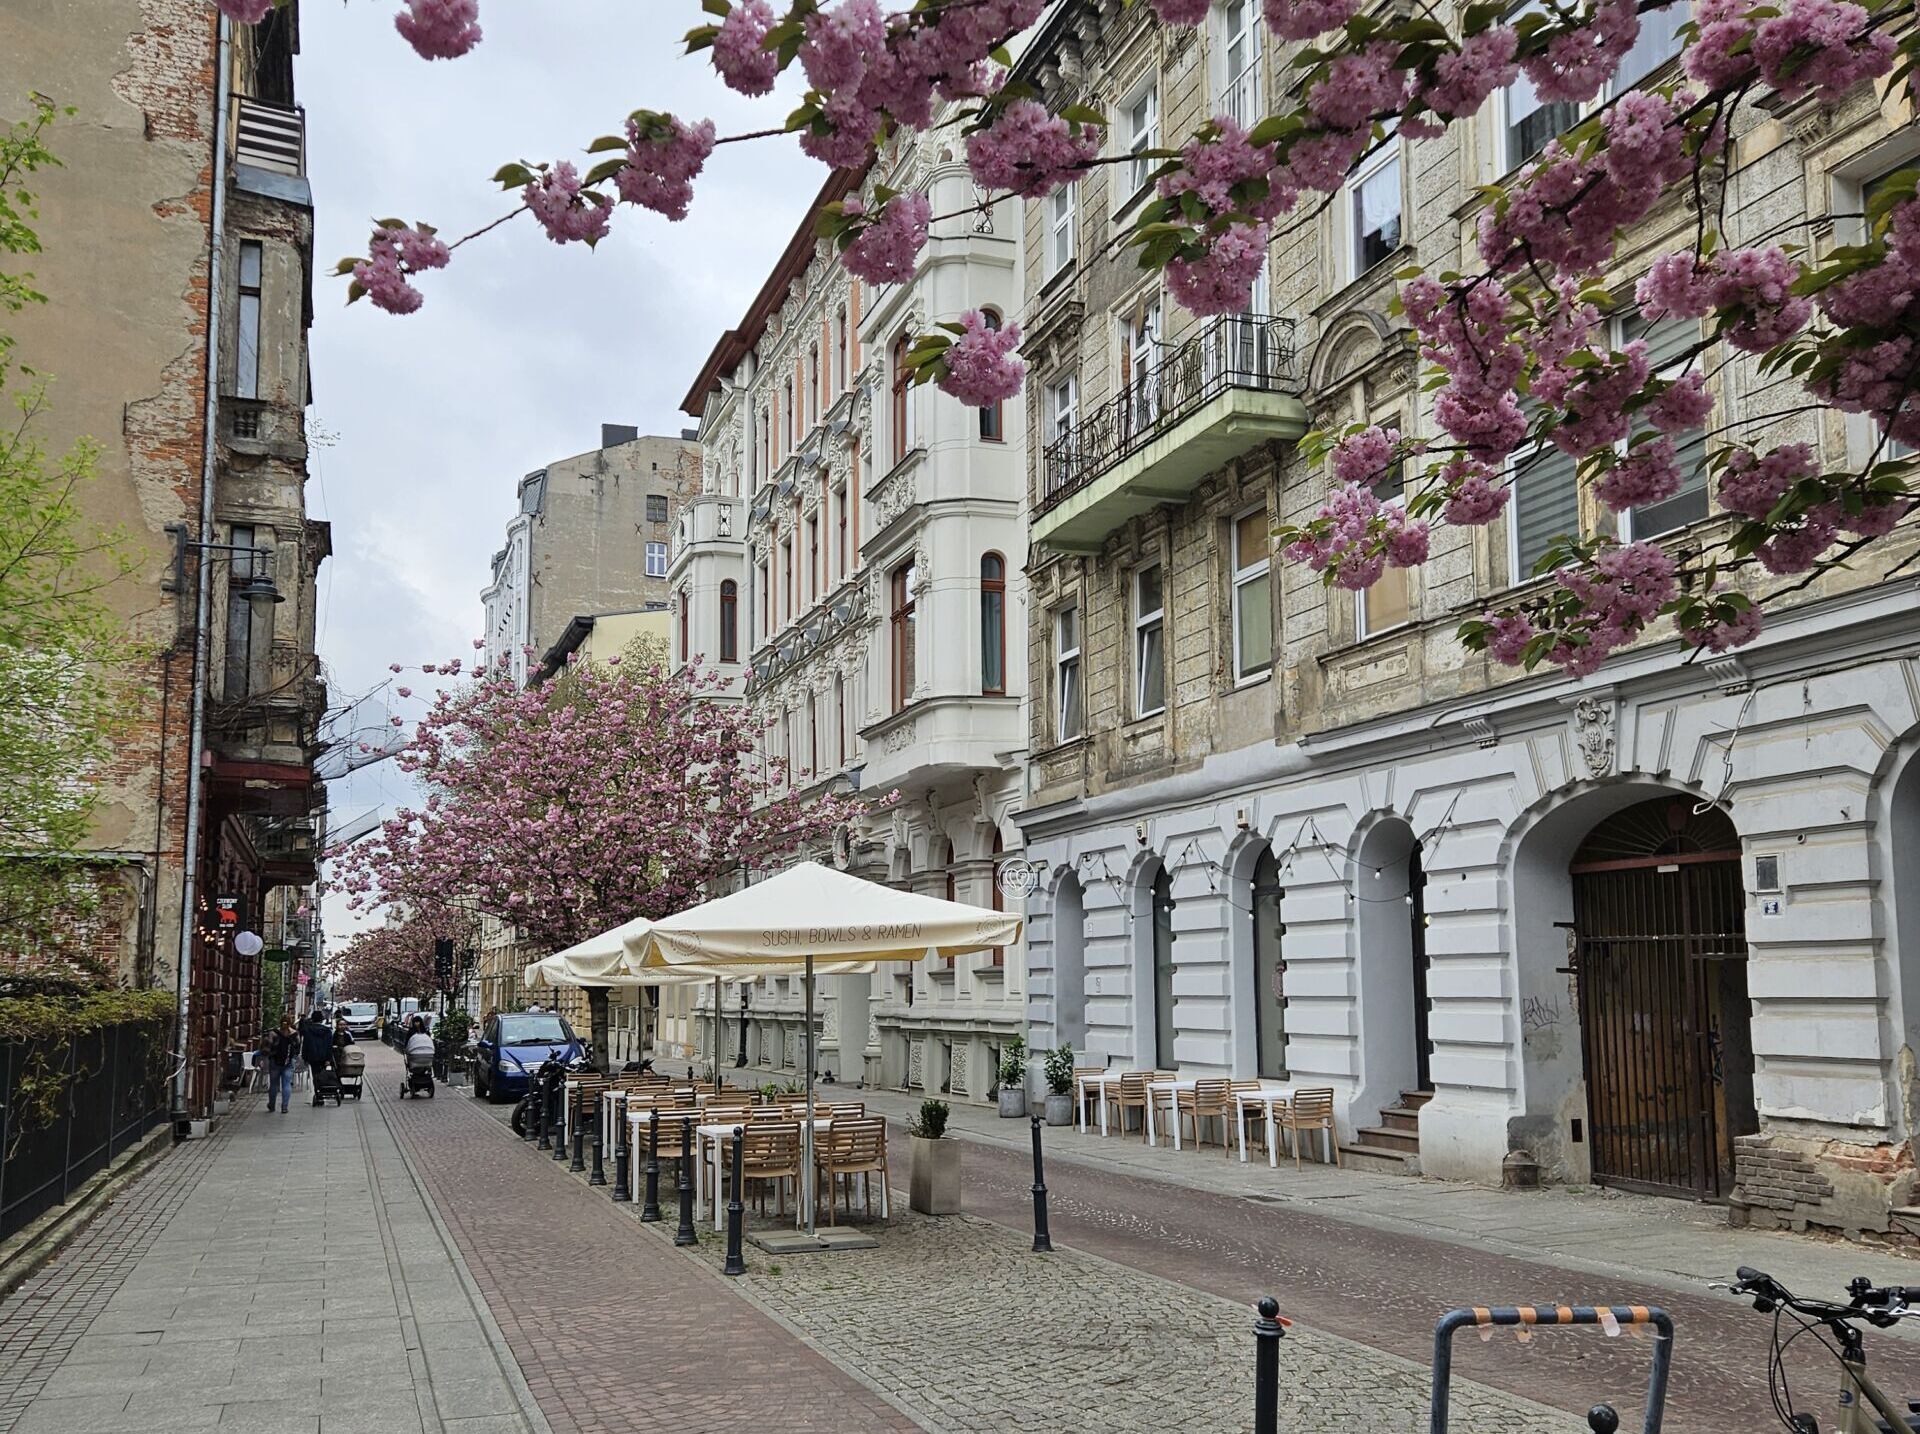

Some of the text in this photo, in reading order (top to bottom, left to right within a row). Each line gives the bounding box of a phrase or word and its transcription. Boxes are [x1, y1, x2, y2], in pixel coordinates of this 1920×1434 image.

[762, 923, 922, 947] SUSHI, BOWLS & RAMEN
